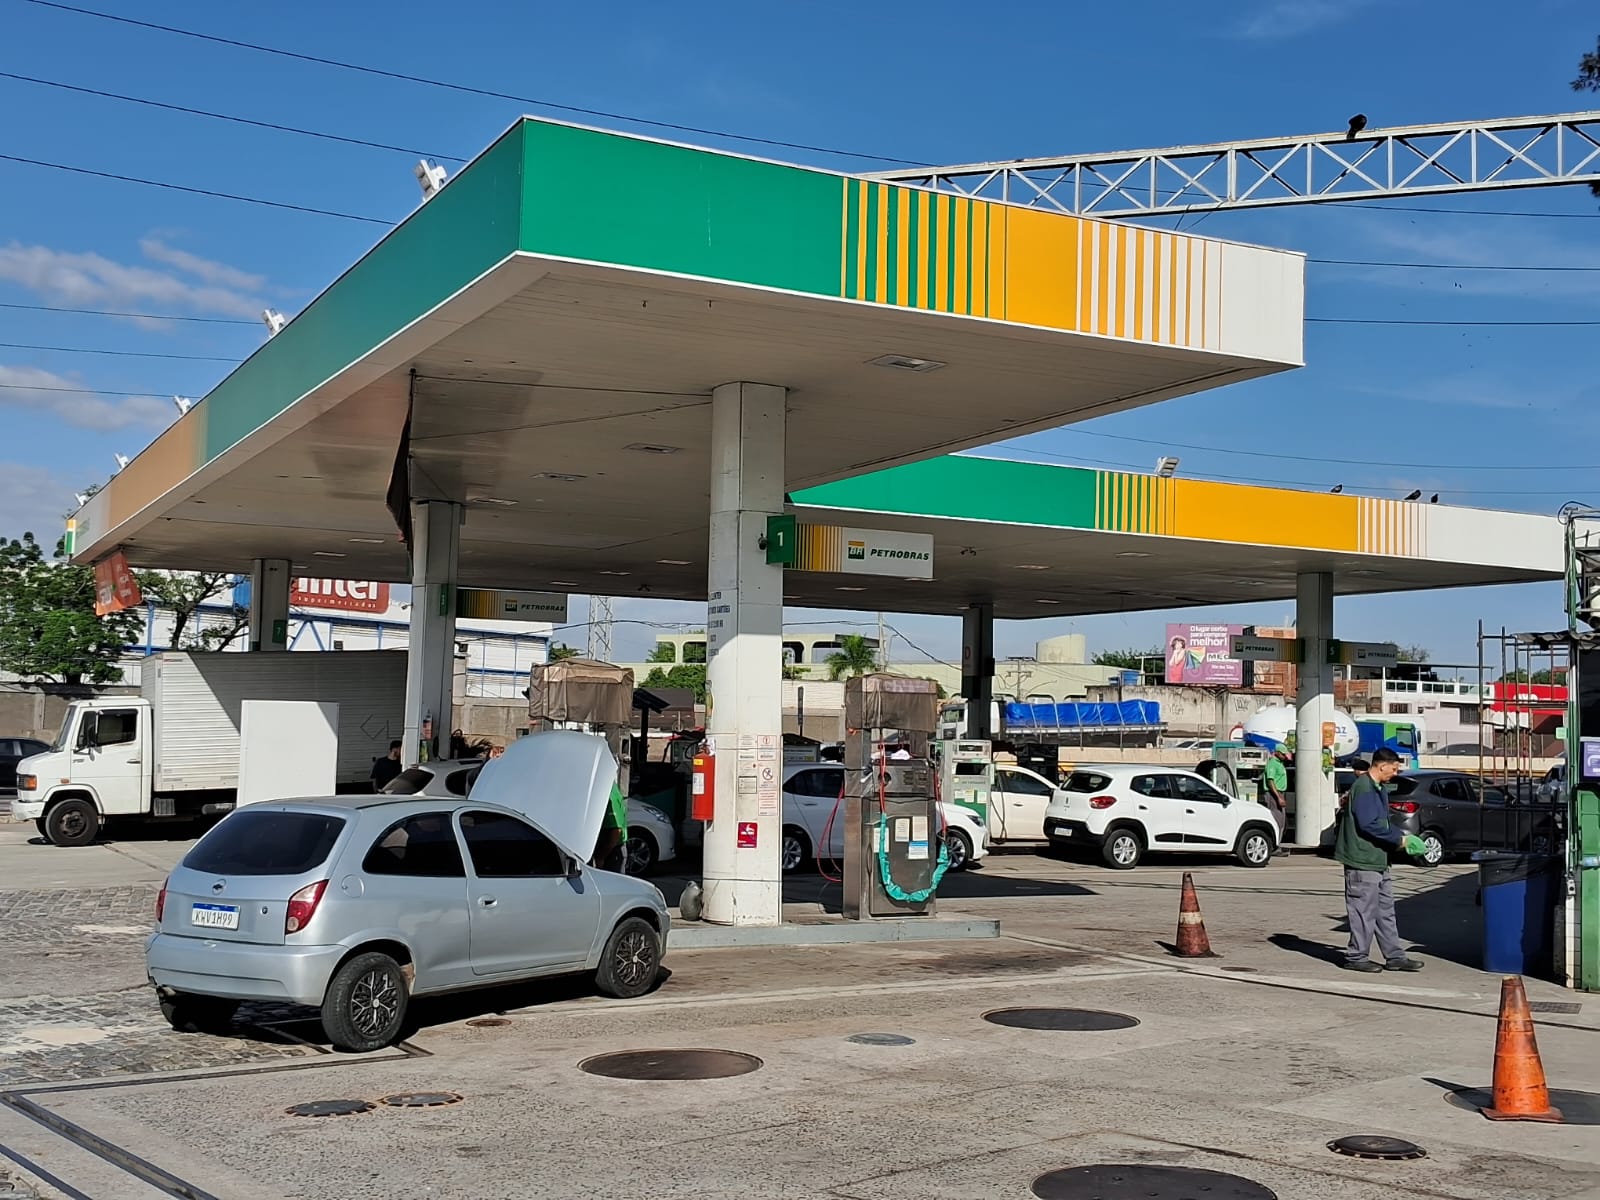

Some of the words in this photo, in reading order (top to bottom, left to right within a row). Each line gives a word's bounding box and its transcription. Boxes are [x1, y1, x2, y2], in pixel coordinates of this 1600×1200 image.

[777, 531, 784, 547] 1
[870, 548, 930, 561] PETROBRAS
[521, 603, 565, 612] PETROBRAS
[1190, 637, 1228, 646] melhor!
